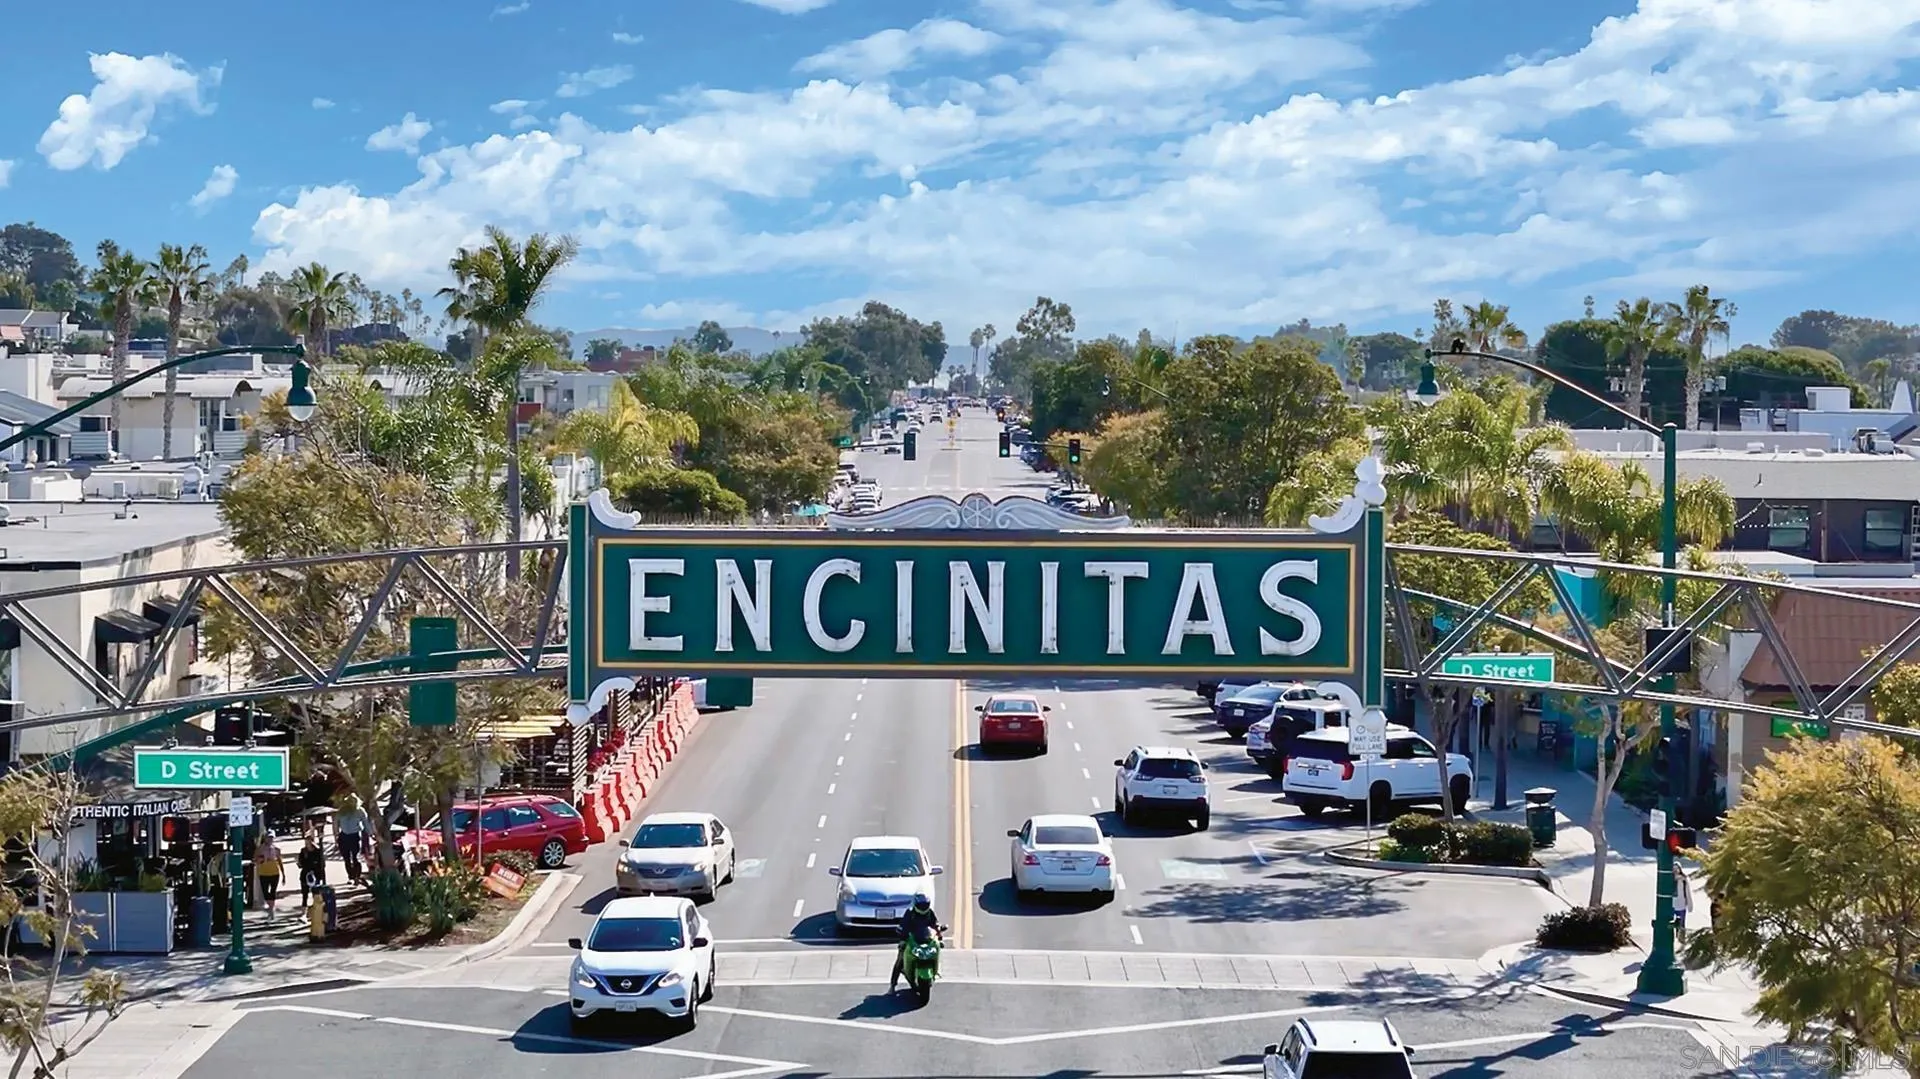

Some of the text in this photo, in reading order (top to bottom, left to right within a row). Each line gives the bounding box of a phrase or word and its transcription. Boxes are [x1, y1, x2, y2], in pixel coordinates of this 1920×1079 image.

[628, 558, 1321, 656] ENCINITAS
[1461, 664, 1534, 678] D Street
[161, 761, 259, 779] D Street
[134, 802, 169, 817] ITALIAN
